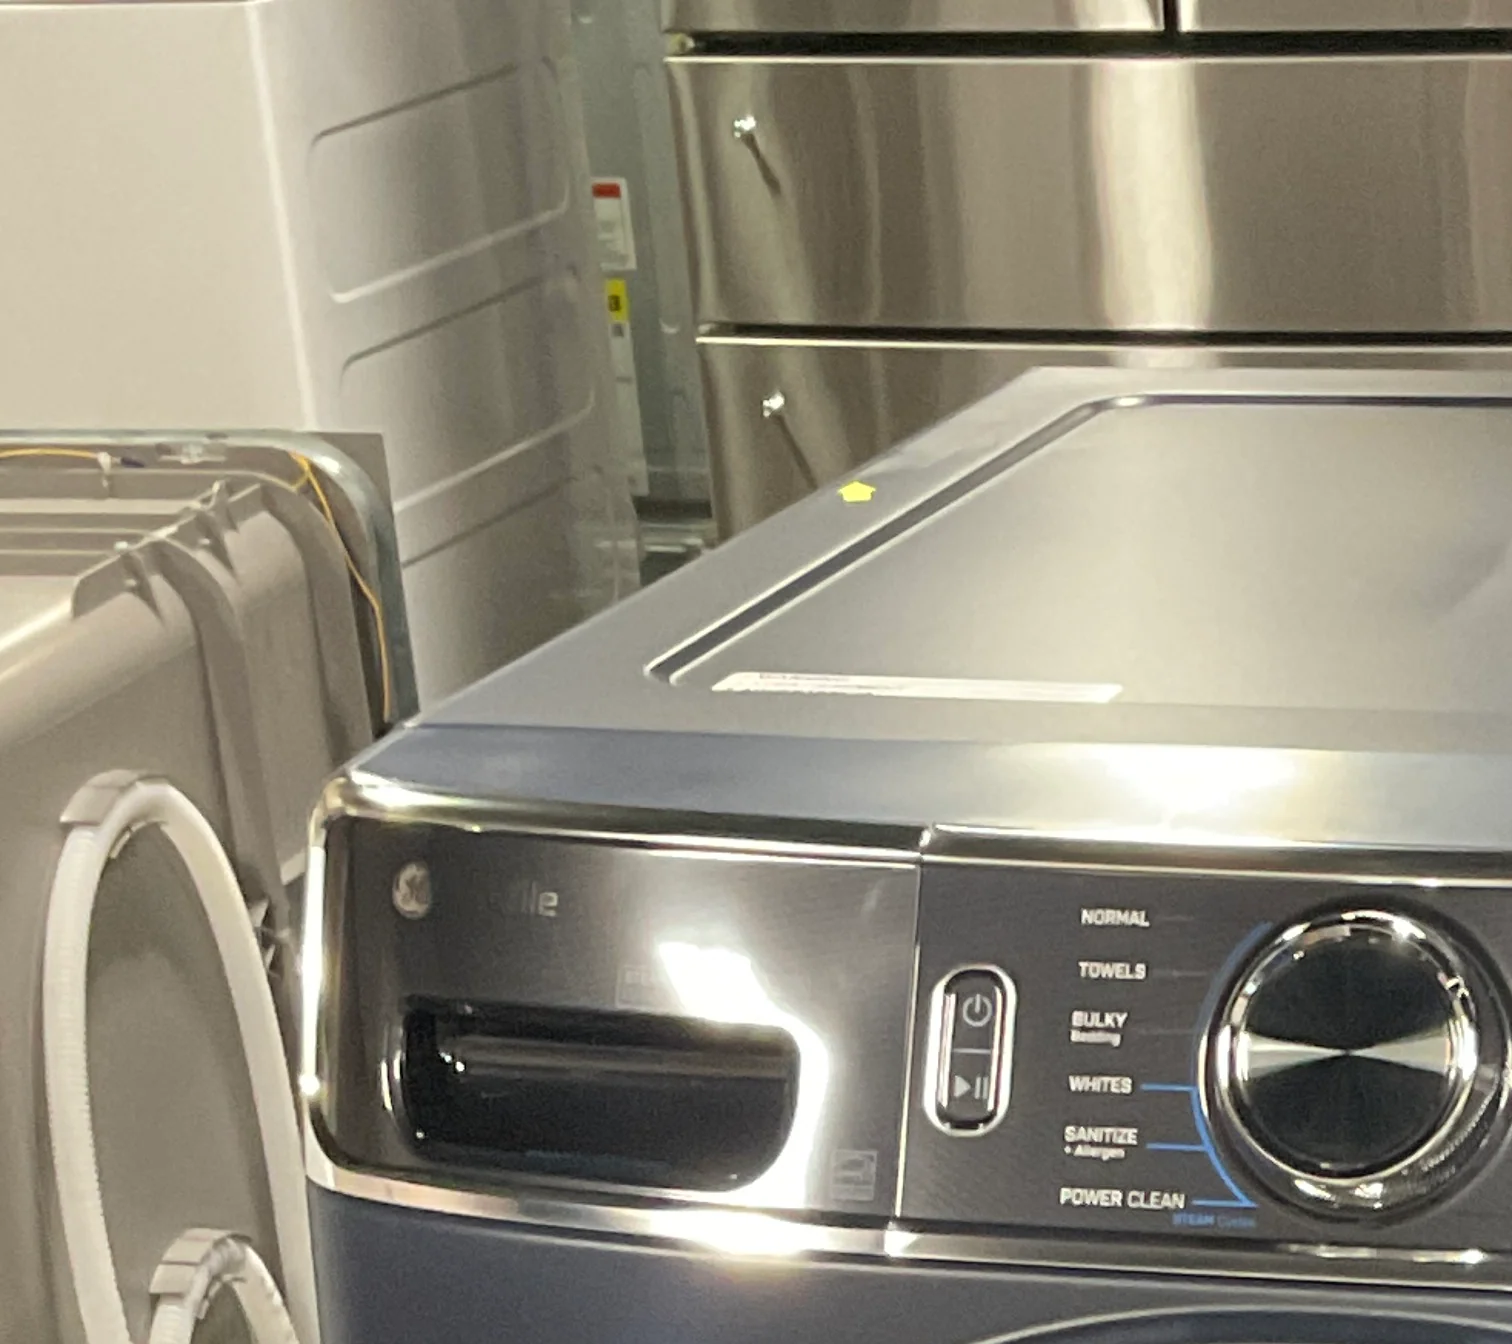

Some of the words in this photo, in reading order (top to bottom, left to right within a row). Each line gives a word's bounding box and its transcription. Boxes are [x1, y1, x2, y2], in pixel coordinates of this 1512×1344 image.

[1081, 908, 1150, 927] NORMAL
[1078, 961, 1146, 980] TOWELS
[1071, 1010, 1128, 1028] BULKY
[1068, 1075, 1133, 1094] WHITES
[1064, 1125, 1138, 1146] SANITIZE
[1059, 1187, 1123, 1207] POWER
[1126, 1190, 1185, 1210] CLEAN
